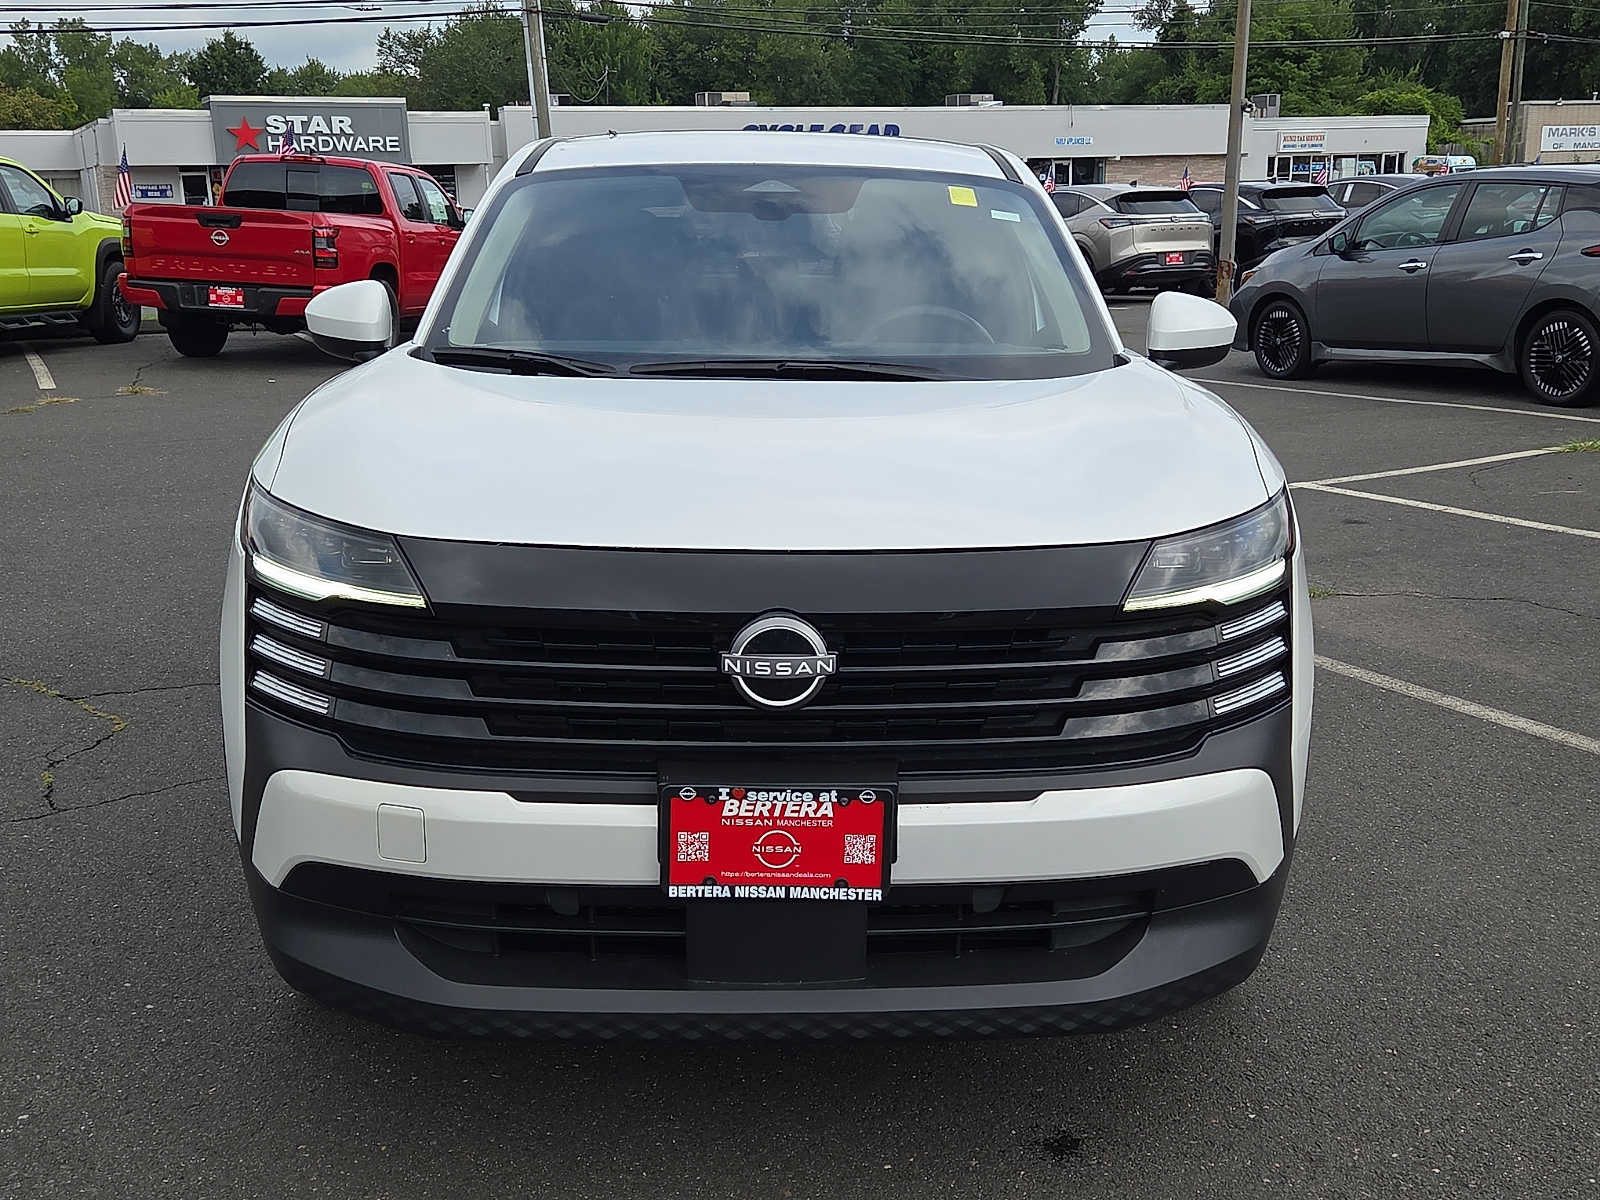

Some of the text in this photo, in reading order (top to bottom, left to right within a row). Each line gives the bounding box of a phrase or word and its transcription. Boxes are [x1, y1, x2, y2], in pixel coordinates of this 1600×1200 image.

[265, 115, 354, 134] STAR
[1547, 127, 1597, 138] MARK'S
[267, 135, 401, 152] HARDWARE
[1552, 142, 1564, 150] OF
[724, 658, 833, 676] NISSAN
[718, 787, 838, 803] I service at
[721, 799, 834, 818] BERTERA
[721, 818, 833, 827] NISSAN MANCHESTER
[752, 845, 802, 854] NISSAN
[668, 885, 882, 901] BERTERA NISSAN MANCHESTER
